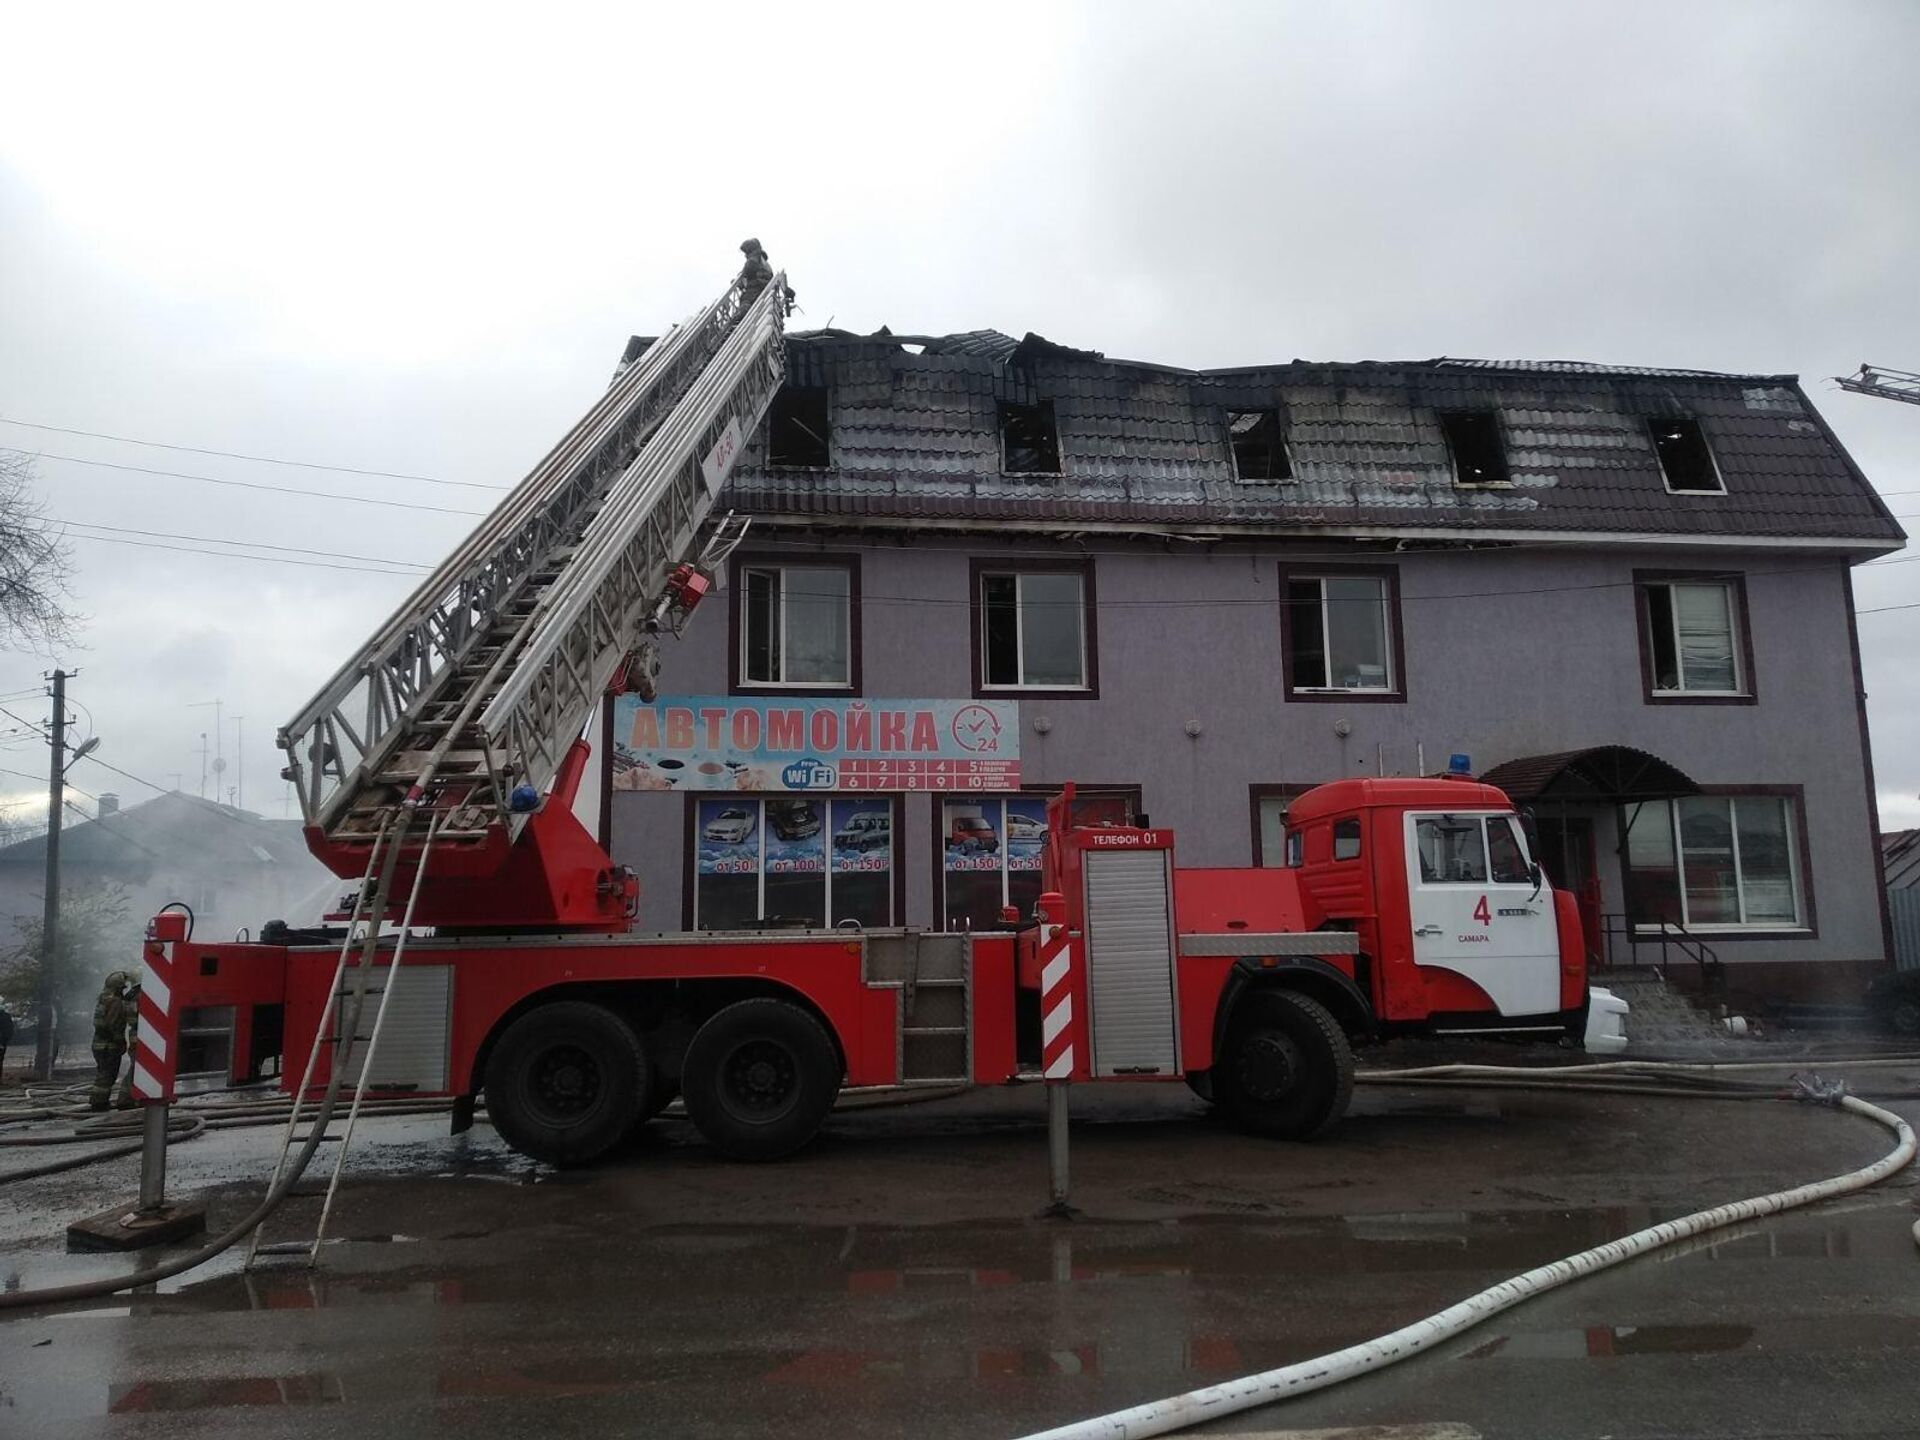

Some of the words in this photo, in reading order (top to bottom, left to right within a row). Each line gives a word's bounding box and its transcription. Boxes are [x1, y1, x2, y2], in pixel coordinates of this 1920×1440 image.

[629, 701, 940, 752] АВТОМОЙКА
[978, 738, 998, 752] 24
[852, 762, 857, 772] 1
[879, 761, 888, 772] 2
[908, 761, 916, 772] 3
[936, 761, 946, 772] 4
[787, 769, 807, 784] Wi
[814, 770, 831, 783] Fi
[849, 777, 858, 788] 6
[879, 777, 888, 788] 7
[908, 777, 916, 787] 8
[936, 776, 946, 787] 9
[1093, 835, 1139, 845] ТЕЛЕФОН
[1143, 832, 1157, 844] 01
[716, 862, 729, 871] от
[775, 862, 788, 871] от
[1011, 860, 1023, 869] от
[1473, 895, 1492, 926] 4
[1458, 934, 1490, 943] САМАРА
